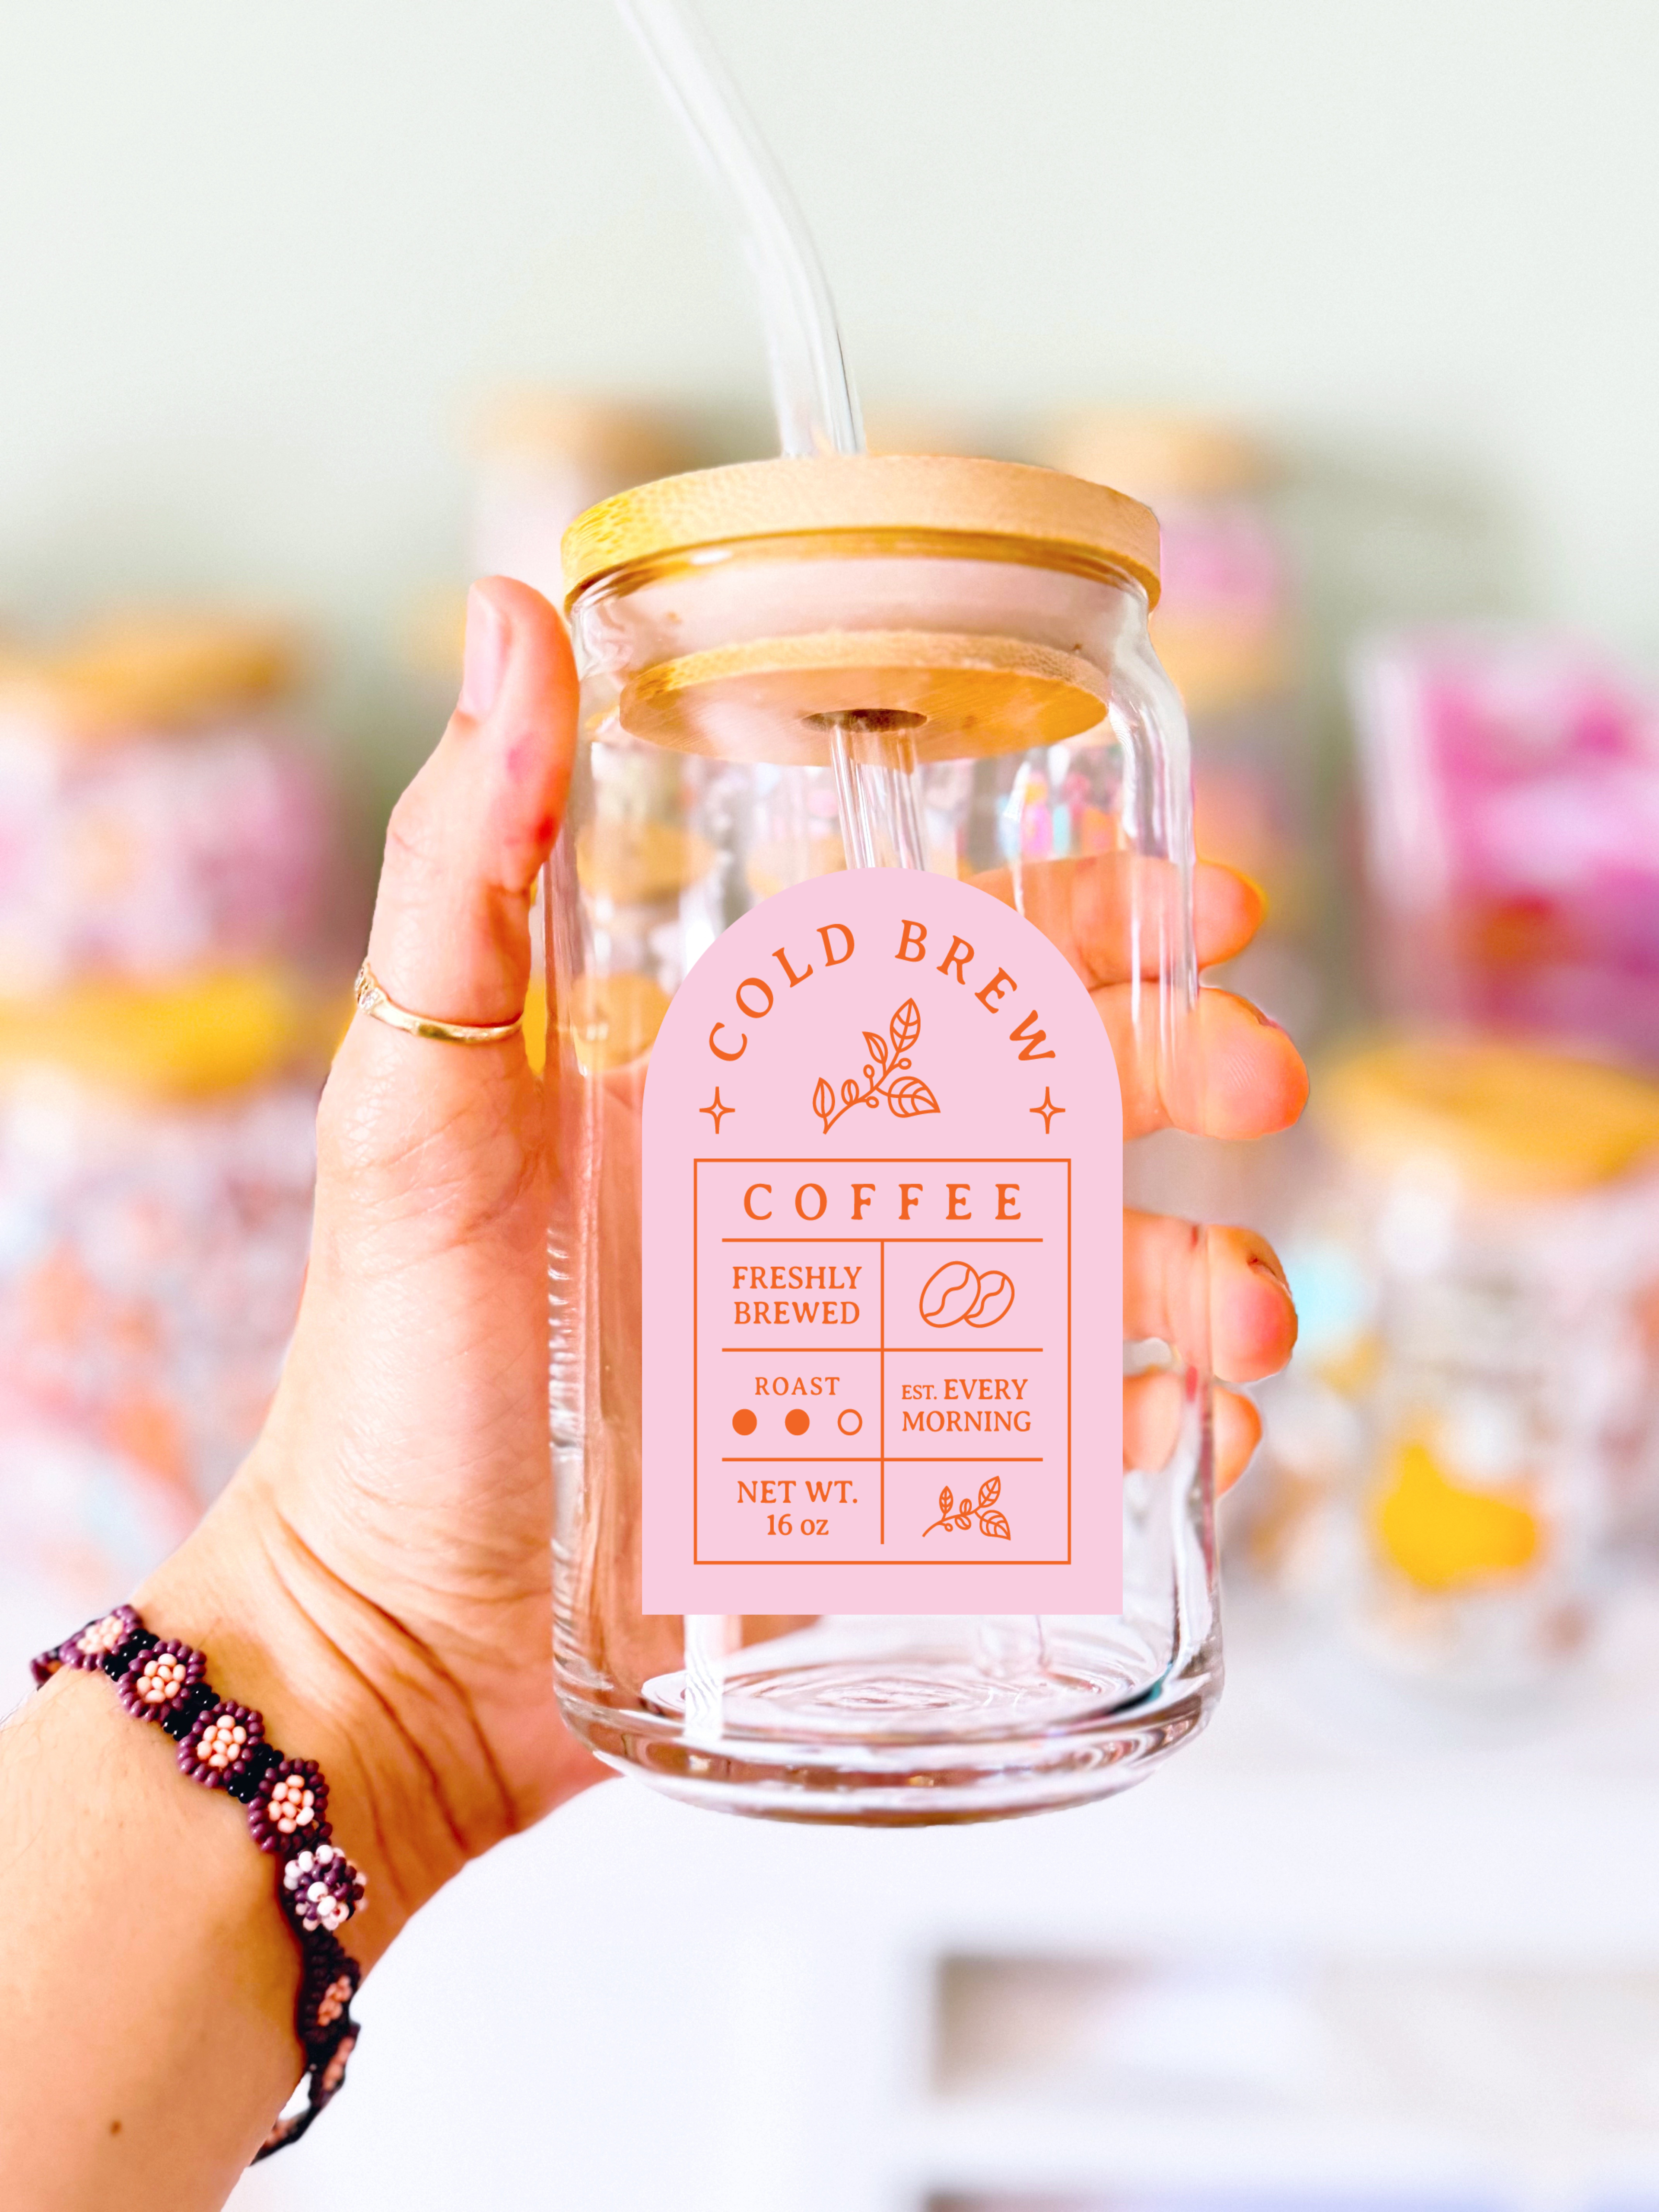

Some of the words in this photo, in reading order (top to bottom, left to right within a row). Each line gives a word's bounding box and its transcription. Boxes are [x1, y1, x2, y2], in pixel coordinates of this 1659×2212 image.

[709, 923, 855, 1062] COLD
[894, 918, 1056, 1062] BREW
[743, 1182, 1021, 1221] COFFEE
[732, 1266, 863, 1290] FRESHLY
[734, 1301, 860, 1325] BREWED
[754, 1376, 840, 1396] ROAST
[901, 1384, 938, 1400] EST.
[943, 1378, 1029, 1400] EVERY
[902, 1410, 1032, 1433] MORNING
[737, 1480, 797, 1504] NET
[804, 1480, 858, 1504] WT.
[766, 1513, 793, 1536] 16
[800, 1519, 830, 1536] oz
